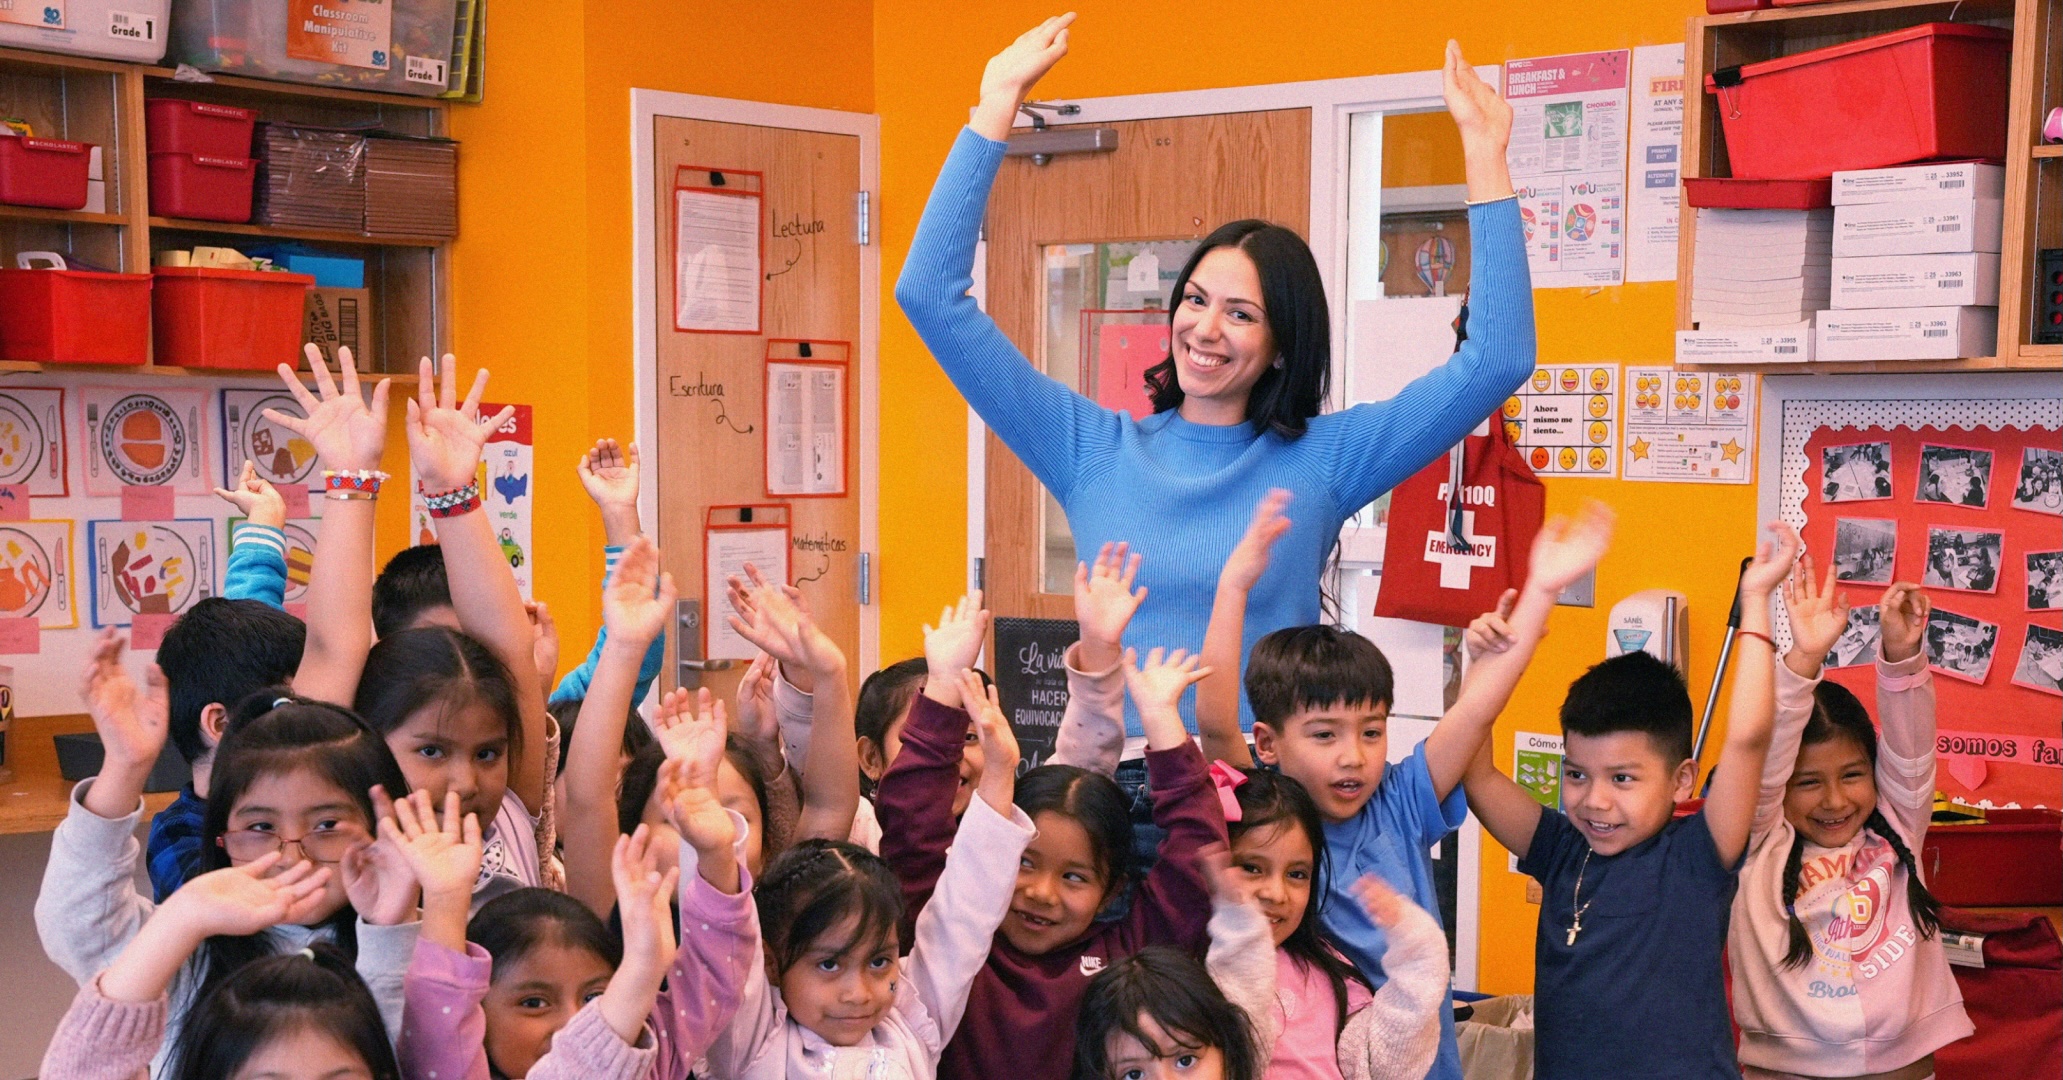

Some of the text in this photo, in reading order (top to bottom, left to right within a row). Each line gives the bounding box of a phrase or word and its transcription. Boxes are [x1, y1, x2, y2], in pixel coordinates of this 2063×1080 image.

[312, 4, 368, 24] Classroom
[111, 21, 153, 40] Grade 1
[303, 20, 377, 42] Manipulative
[331, 41, 348, 54] Kit
[407, 65, 443, 82] Grade 1
[1509, 68, 1566, 85] BREAKFAST &
[1508, 83, 1537, 96] LUNCH
[203, 106, 243, 117] SCHOLASTIC
[1586, 100, 1616, 109] CHOKING
[34, 141, 79, 150] SCHOLASTIC
[204, 157, 244, 167] SCHOLASTIC
[772, 208, 825, 238] Lectura
[669, 371, 726, 398] Escritura
[503, 448, 518, 457] azul
[499, 511, 517, 520] verde
[791, 531, 847, 552] Matemáticas
[1429, 539, 1492, 558] EMERNCY
[1019, 641, 1066, 675] La vid
[1031, 689, 1068, 707] HACER
[1528, 737, 1557, 750] Cómo
[1936, 735, 2063, 766] somos fa
[1812, 932, 1826, 952] HIGH
[1858, 924, 1917, 979] SIDE
[1080, 955, 1102, 969] NIKE
